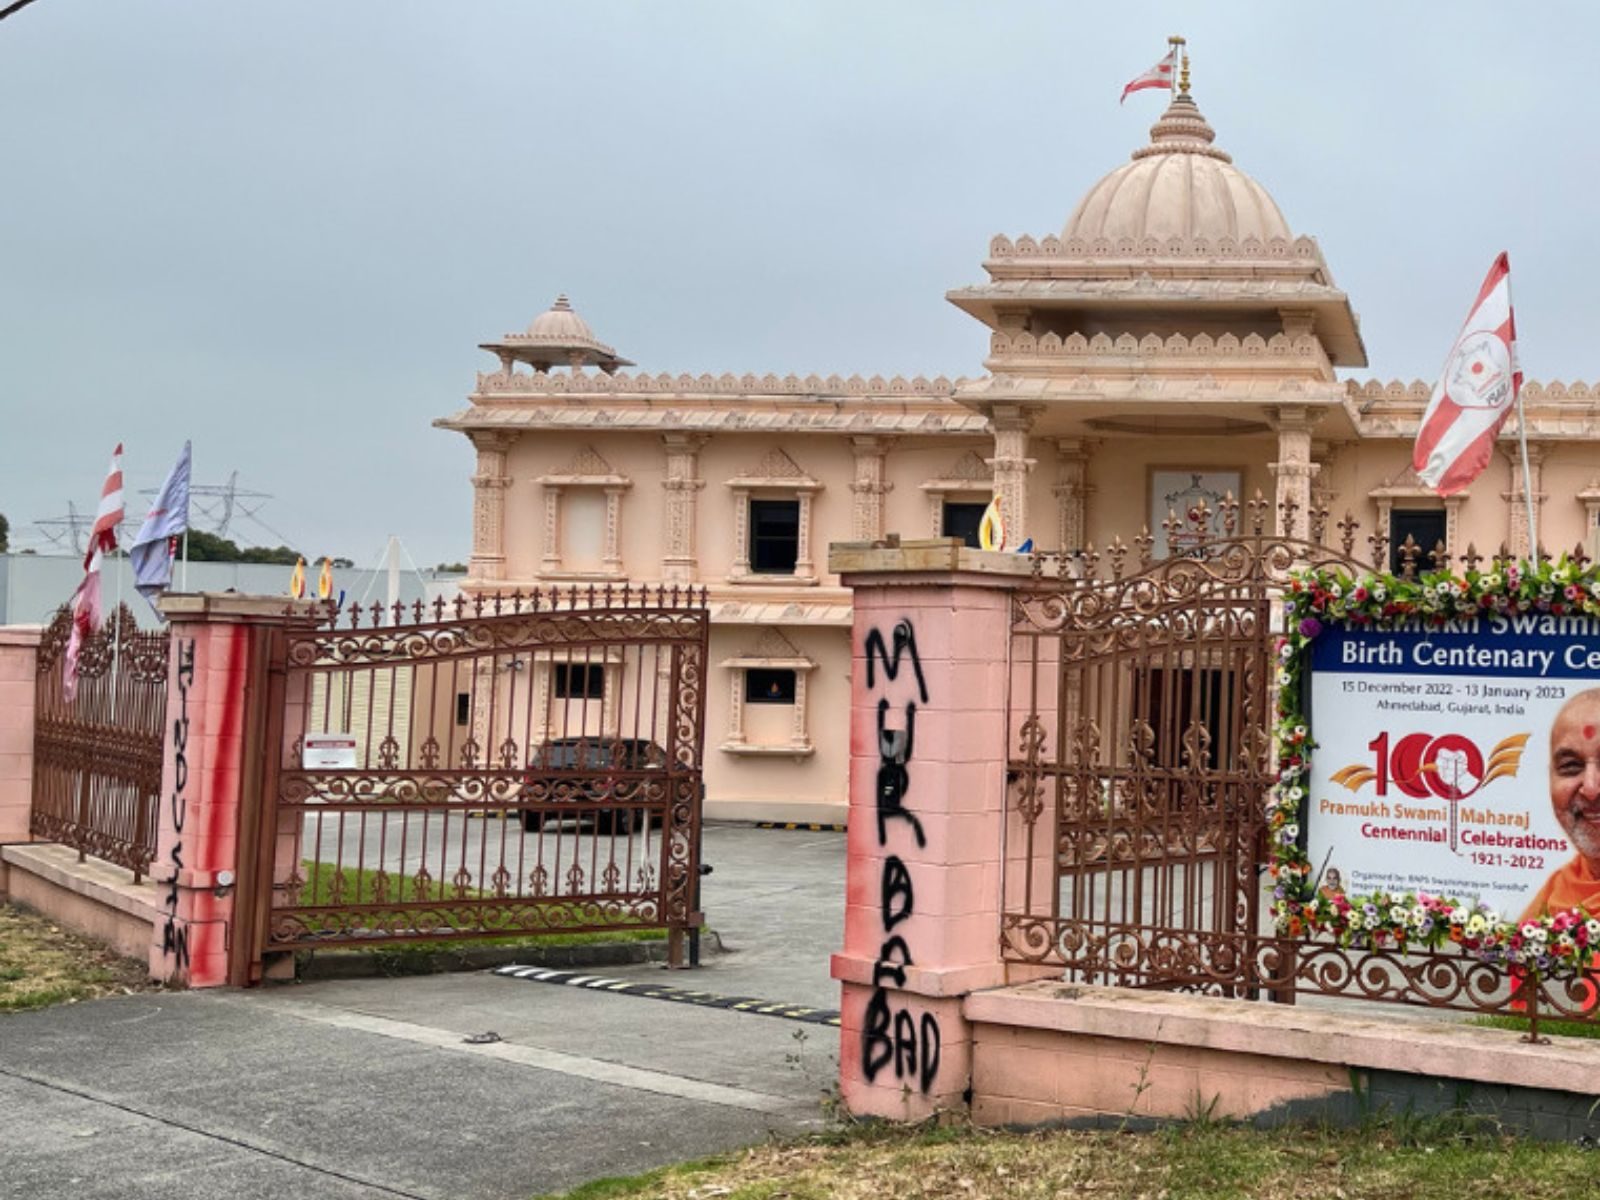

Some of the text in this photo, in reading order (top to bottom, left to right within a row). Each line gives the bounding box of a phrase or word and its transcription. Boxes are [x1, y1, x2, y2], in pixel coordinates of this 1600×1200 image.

[1342, 640, 1600, 676] Birth Centenary Ce
[1342, 680, 1355, 693] 15
[1357, 680, 1422, 695] December
[1424, 683, 1453, 695] 2022
[1465, 684, 1479, 696] 13
[1482, 684, 1530, 701] January
[1535, 685, 1566, 699] 2023
[1494, 703, 1525, 715] India
[1368, 731, 1485, 801] 100
[1320, 799, 1530, 831] Pramukh Swami Maharaj
[1361, 823, 1568, 851] Centennial Celebrations
[1471, 852, 1544, 870] 1921-2022
